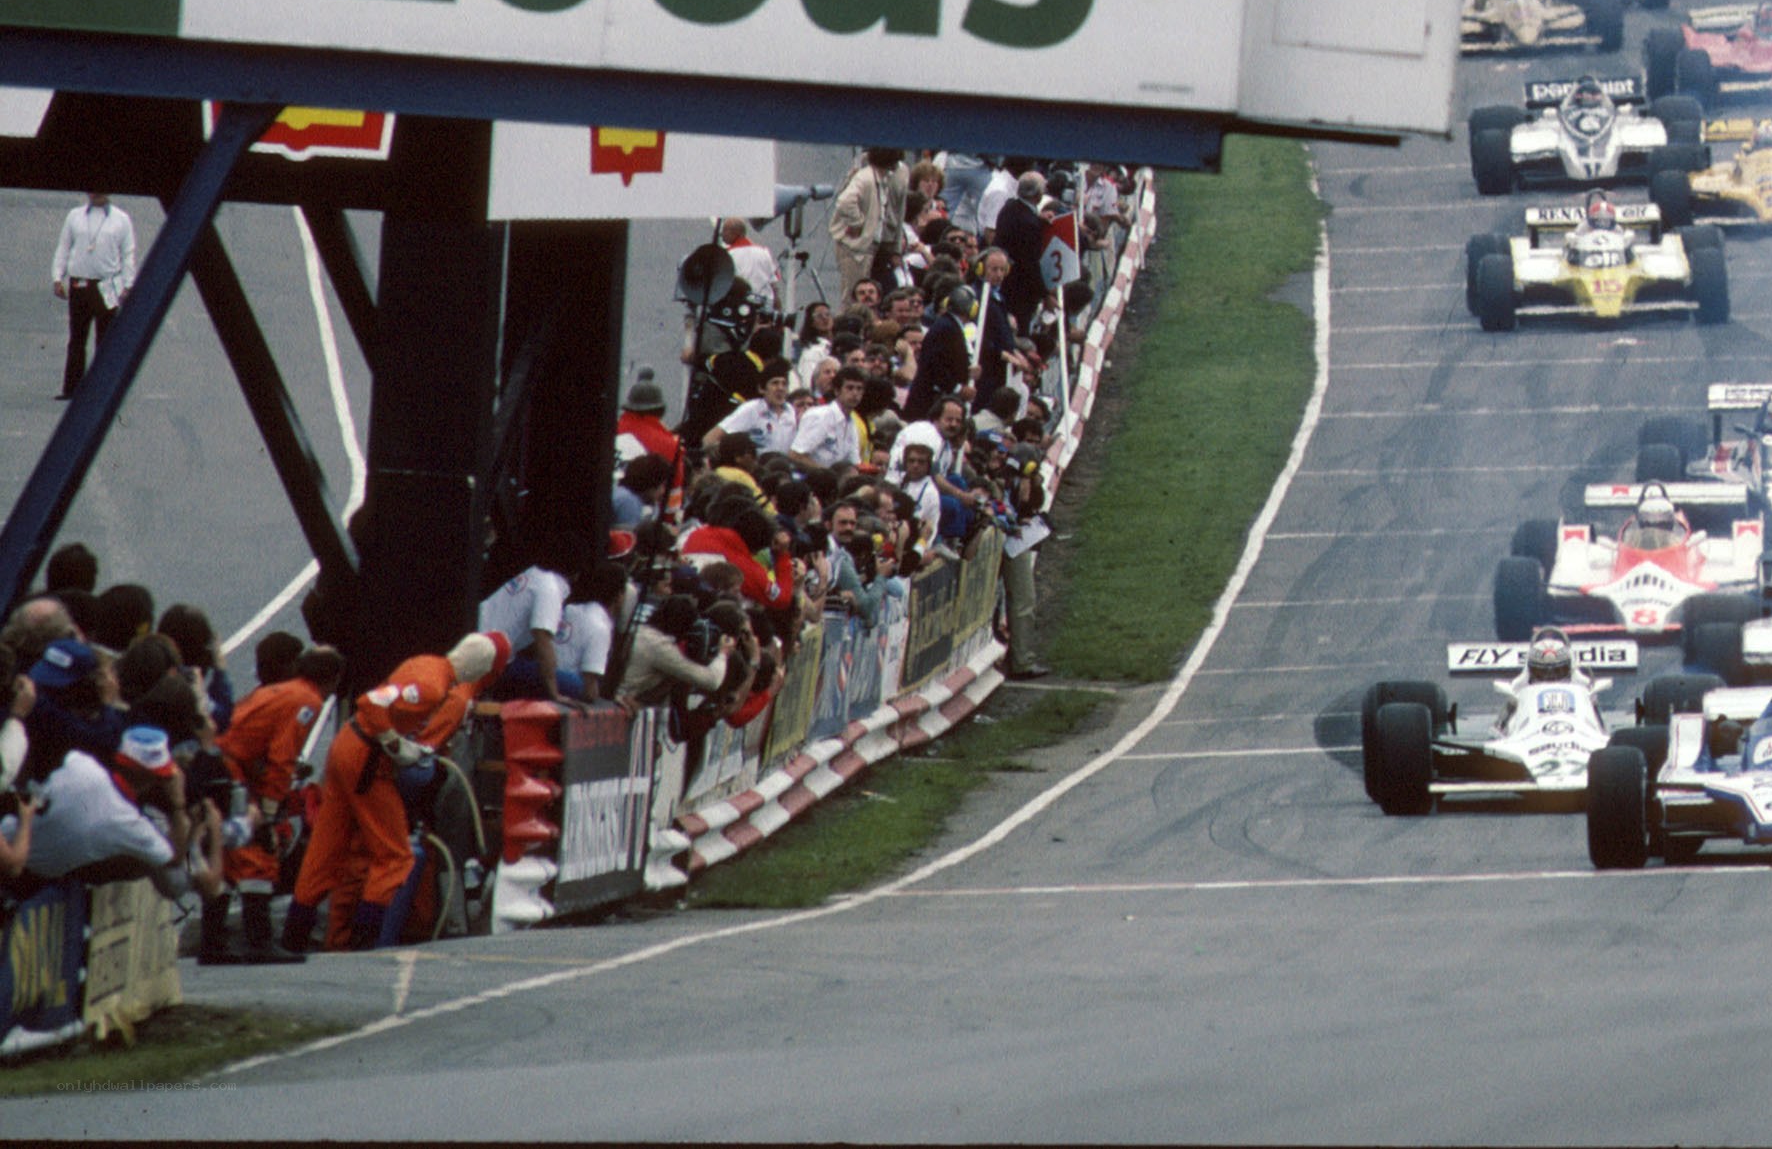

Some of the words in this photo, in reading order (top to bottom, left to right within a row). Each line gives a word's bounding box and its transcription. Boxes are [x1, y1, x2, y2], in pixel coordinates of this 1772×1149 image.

[1532, 78, 1635, 102] parlat
[1538, 207, 1588, 221] RENA
[1050, 249, 1063, 283] 3
[1592, 279, 1623, 294] 15
[1458, 648, 1512, 665] FLY
[1517, 647, 1627, 665] sdia
